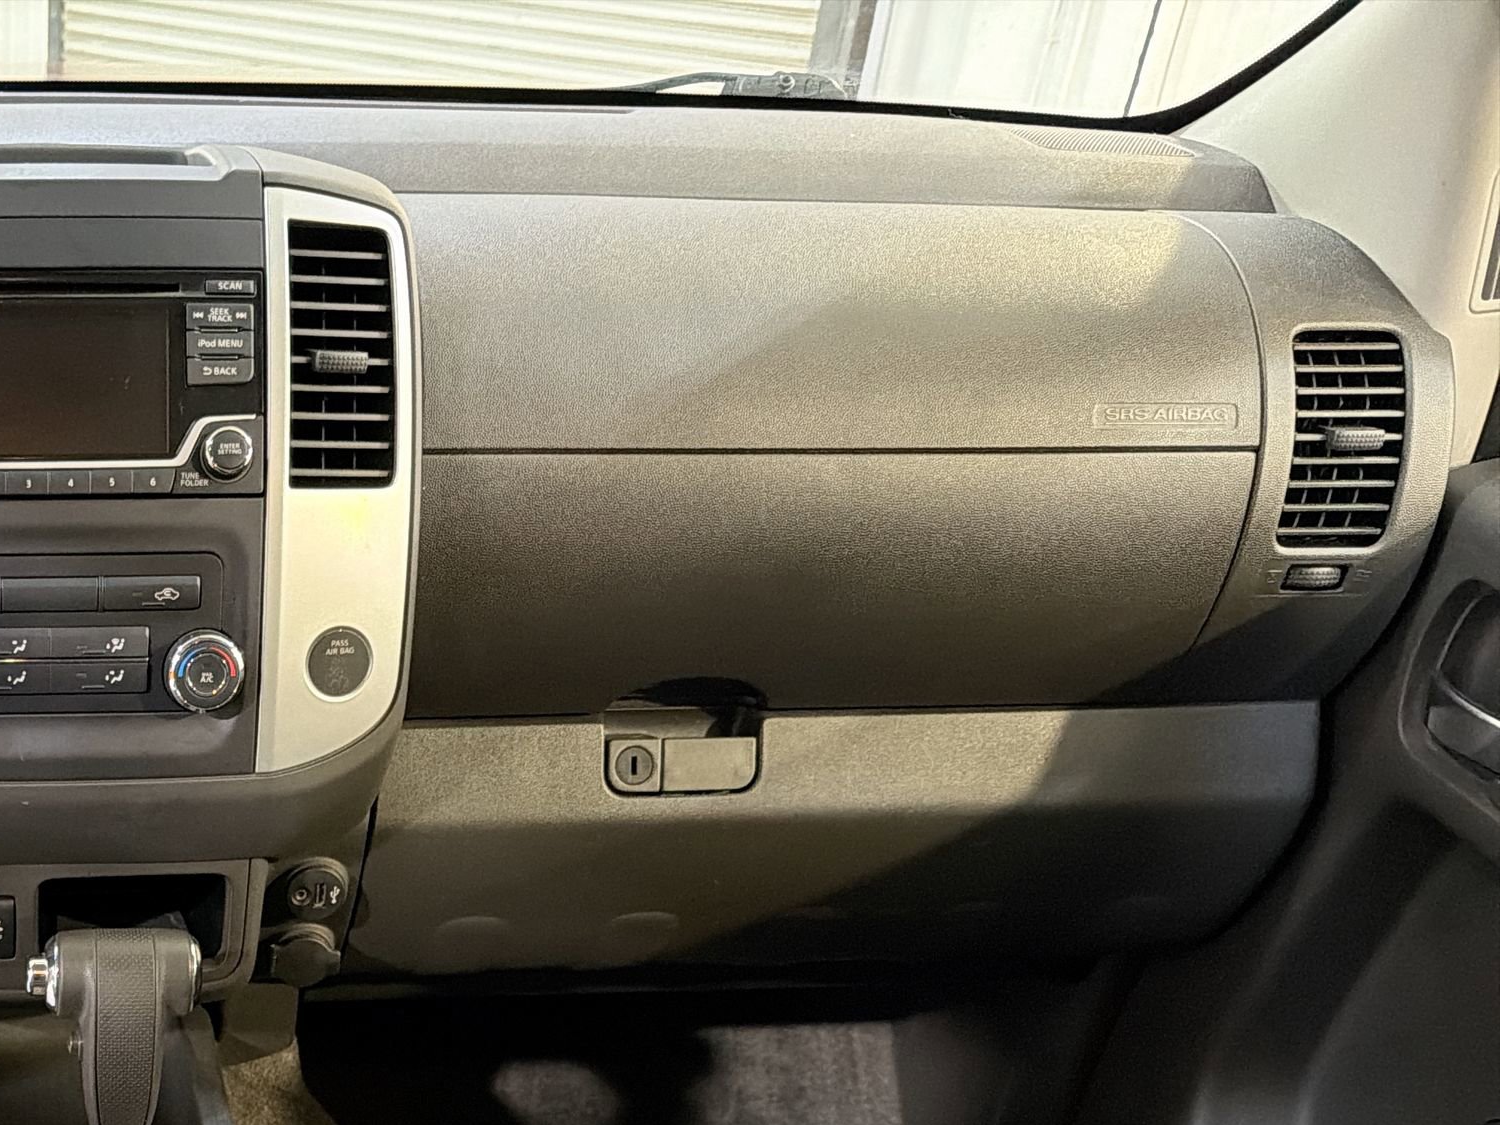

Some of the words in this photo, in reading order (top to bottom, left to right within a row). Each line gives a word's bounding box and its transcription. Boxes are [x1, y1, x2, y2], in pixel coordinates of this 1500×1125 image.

[218, 280, 243, 290] SCAN
[209, 307, 230, 315] SEEK
[197, 339, 216, 348] iPod
[217, 339, 243, 348] MENU
[213, 366, 238, 376] BACK
[1105, 407, 1149, 421] SRS
[1153, 406, 1229, 421] AIRBAG
[180, 472, 199, 480] TUNE
[26, 479, 32, 489] 3
[68, 478, 74, 487] 4
[109, 477, 116, 487] 5
[150, 477, 157, 487] 6
[180, 479, 209, 487] FOLDER
[330, 639, 349, 647] PASS
[325, 648, 338, 656] AIR
[339, 646, 355, 655] BAG
